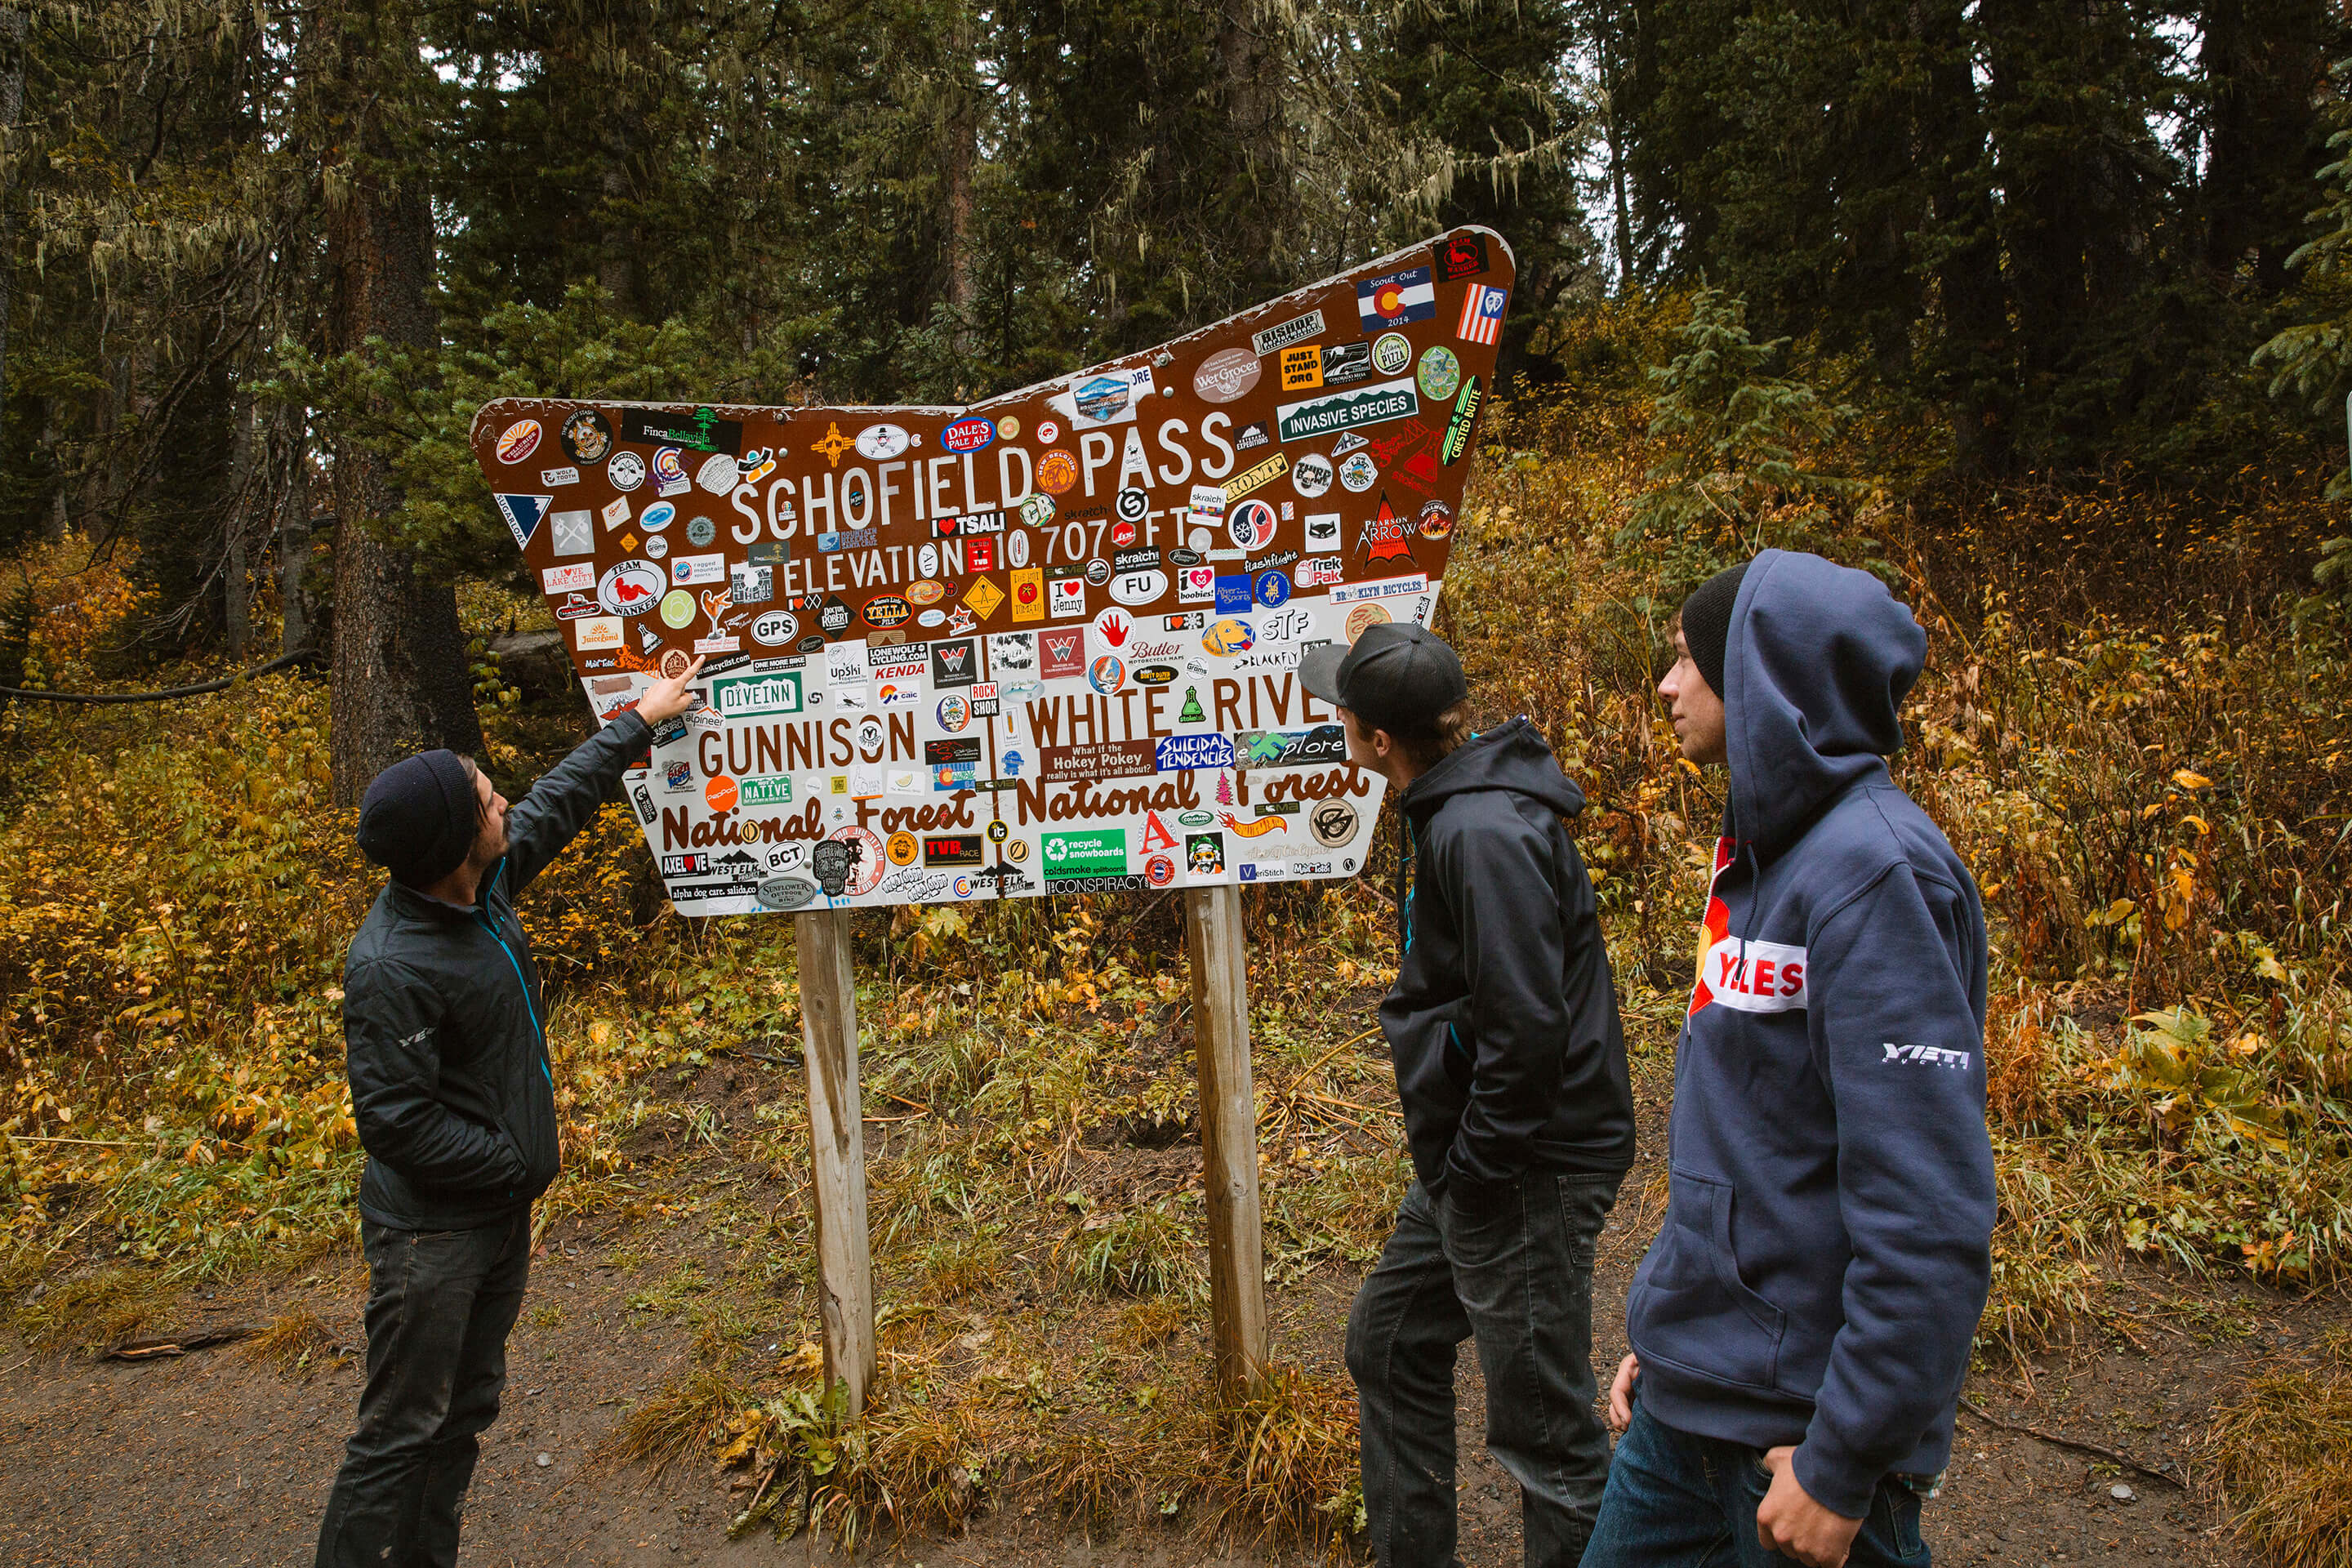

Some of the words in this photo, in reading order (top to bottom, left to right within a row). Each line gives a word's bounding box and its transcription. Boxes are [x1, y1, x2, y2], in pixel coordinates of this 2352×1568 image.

[1370, 275, 1396, 288] Scout
[1399, 270, 1419, 282] Out
[1388, 315, 1410, 327] 2014
[1261, 314, 1315, 344] BISHOP
[1287, 350, 1313, 362] JUST
[1381, 350, 1405, 368] PIZZA
[1218, 360, 1258, 380] Grocer
[1284, 360, 1318, 373] STAND
[1287, 373, 1313, 384] .ORG
[566, 412, 579, 427] SECRET
[1290, 408, 1348, 434] INVASIVE
[1352, 395, 1408, 421] SPECIES
[947, 421, 989, 440] DALE'S
[1451, 415, 1471, 458] CRESTED
[1465, 389, 1481, 418] BUTTE
[506, 431, 537, 458] TELLURIDE
[948, 437, 969, 450] PALE
[973, 434, 990, 446] ALE
[1236, 436, 1269, 451] EXPEDITIONS
[1039, 458, 1047, 475] NEW
[1049, 452, 1076, 471] BELGIUM
[732, 447, 1032, 545] SCHOFIELD
[1080, 411, 1235, 497] PASS
[1226, 457, 1284, 500] ROMP
[1192, 493, 1222, 504] skratch
[497, 494, 527, 546] SUGARLOAF
[932, 519, 938, 537] I
[956, 513, 1005, 533] TSALI
[1365, 516, 1408, 532] PEARSON
[841, 528, 877, 537] MOUNTAIN
[1354, 522, 1417, 557] ARROW
[783, 538, 964, 597] ELEVATIN
[996, 519, 1107, 570] 10,707
[923, 552, 935, 572] Au
[1116, 550, 1155, 565] skratch
[1244, 550, 1298, 573] flashflight
[1312, 559, 1341, 571] Trek
[612, 561, 642, 575] TEAM
[546, 577, 569, 587] LAKE
[572, 572, 593, 582] CITY
[1180, 570, 1189, 590] i
[1313, 571, 1340, 583] Pak
[1055, 583, 1063, 598] I
[1125, 576, 1152, 595] FU
[1383, 581, 1422, 596] BICYCLES
[1180, 590, 1214, 599] boobies!
[612, 596, 658, 616] WANKER
[823, 606, 844, 617] DOCTOR
[867, 604, 909, 619] YELLA
[1054, 599, 1083, 612] Jenny
[822, 612, 849, 627] ROBERT
[757, 619, 793, 637] GPS
[870, 644, 916, 657] LONEWOLF
[1130, 641, 1181, 658] Butler
[769, 659, 788, 667] MORE
[789, 657, 805, 665] BIKE
[871, 653, 928, 666] CYCLING.COM
[1250, 652, 1298, 667] BLACKFLY
[831, 664, 861, 680] UpSki
[875, 663, 925, 680] KENDA
[1187, 662, 1207, 675] Groms
[726, 684, 791, 707] DIVEINN
[973, 684, 996, 698] ROCK
[973, 700, 998, 715] SHOX
[686, 713, 724, 727] alpineer
[698, 711, 915, 778] GUNNISON
[1026, 686, 1173, 749] WHITE
[1213, 672, 1344, 733] RIVE
[1072, 746, 1097, 755] What
[1098, 746, 1107, 754] if
[1107, 744, 1122, 753] the
[1161, 734, 1232, 753] SUICIDAL
[933, 761, 975, 773] LEGALIZED
[1054, 755, 1097, 770] Hokey
[1102, 753, 1143, 768] Pokey
[1157, 750, 1233, 769] TENDENCIES
[1047, 771, 1069, 781] really
[1079, 768, 1098, 777] what
[1100, 768, 1111, 777] it's
[1112, 766, 1123, 775] all
[1125, 764, 1152, 774] about?
[707, 786, 737, 800] PepPod
[745, 784, 789, 799] NATIVE
[662, 796, 826, 852] Natinal
[852, 789, 977, 834] Forest
[1017, 769, 1200, 826] National
[994, 828, 1005, 837] it
[1138, 809, 1180, 856] A
[926, 840, 961, 856] TVB
[1068, 839, 1102, 850] recycle
[768, 846, 800, 868] BCT
[960, 849, 980, 858] RACE
[1068, 847, 1125, 858] snowboards
[709, 865, 737, 875] WEST
[739, 863, 761, 874] ELK
[1044, 865, 1091, 876] coldsmoke
[1093, 865, 1127, 875] splitboards
[763, 883, 810, 896] SUNFLOWER
[969, 877, 1000, 890] WEST
[1004, 875, 1026, 887] ELK
[1055, 875, 1145, 894] CONSPIRACY
[673, 889, 693, 901] alpha
[694, 889, 707, 898] dog
[709, 889, 725, 897] care.
[727, 884, 757, 896] salida,co
[1882, 1043, 1971, 1065] YETI
